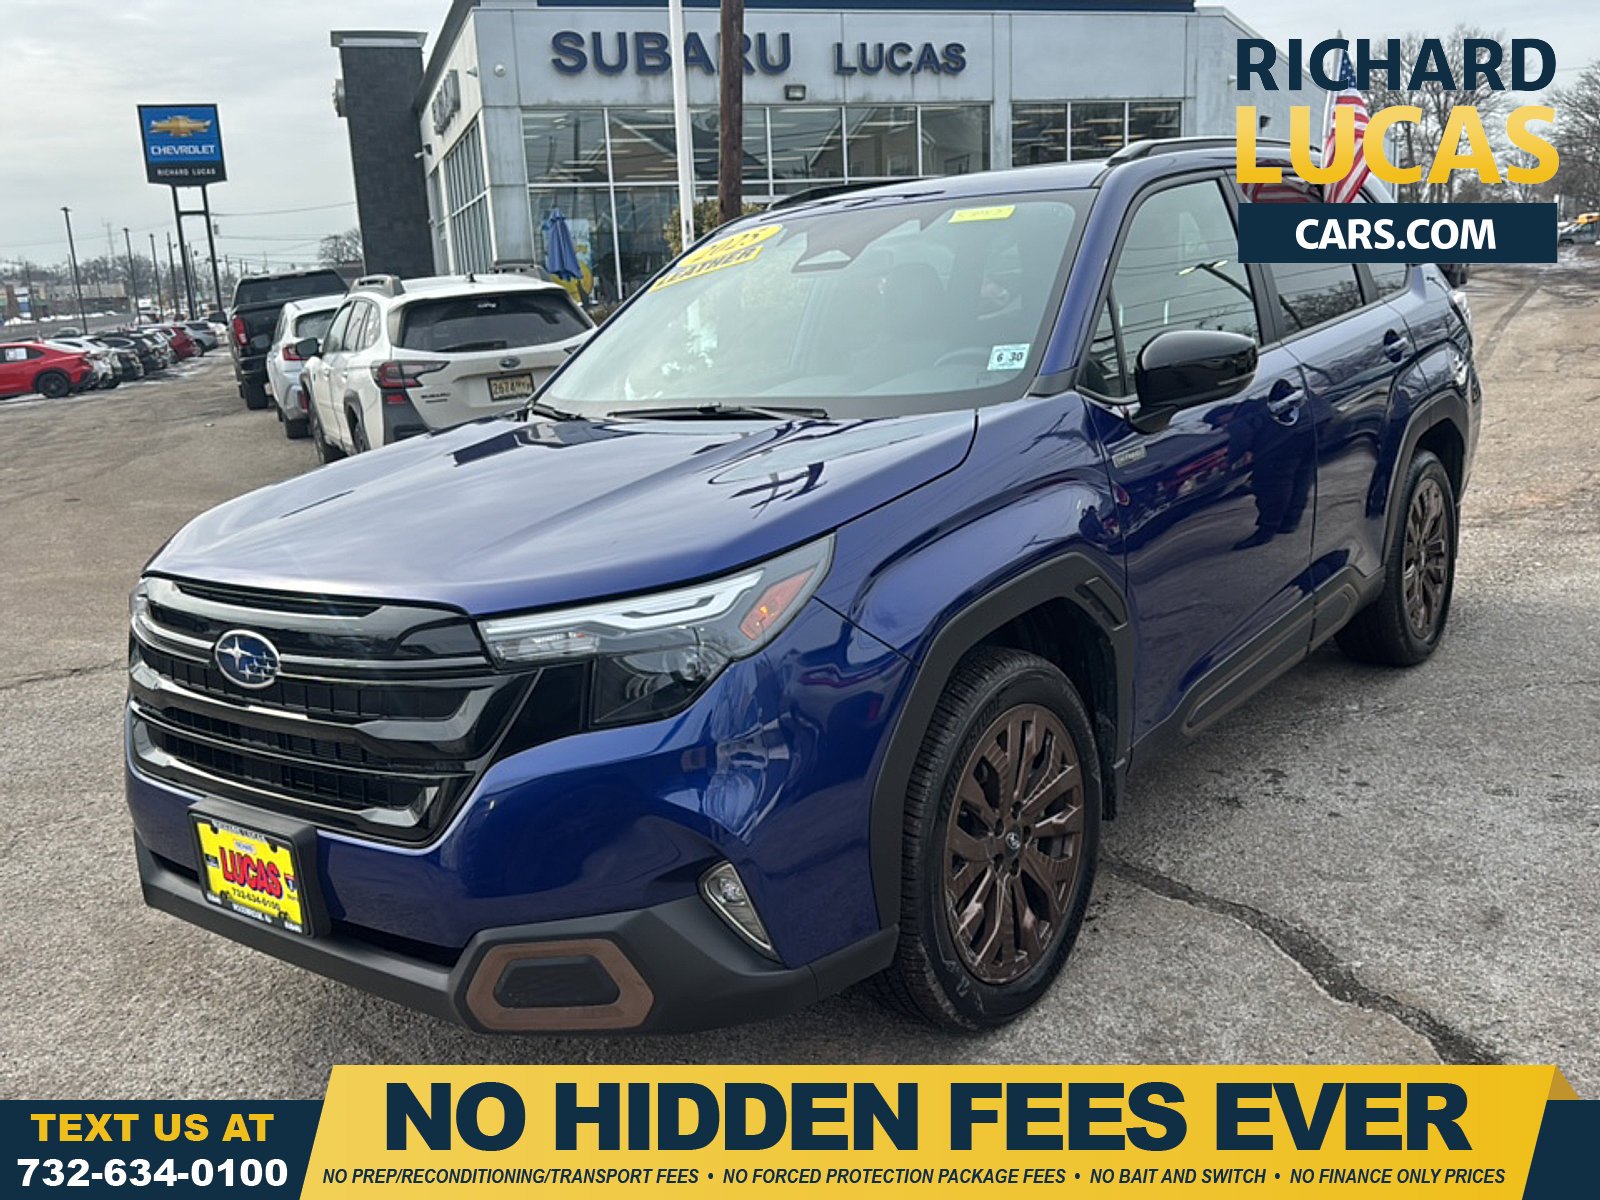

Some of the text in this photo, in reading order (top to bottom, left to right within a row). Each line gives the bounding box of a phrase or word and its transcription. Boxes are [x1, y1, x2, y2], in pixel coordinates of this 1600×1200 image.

[833, 42, 967, 76] LUCAS
[150, 144, 215, 155] CHEVROLET
[156, 167, 216, 176] RICHARD LUCAS
[690, 227, 768, 262] 2025
[655, 245, 758, 288] LEATHER
[996, 351, 1024, 363] 6 30
[219, 846, 285, 900] LUCAS
